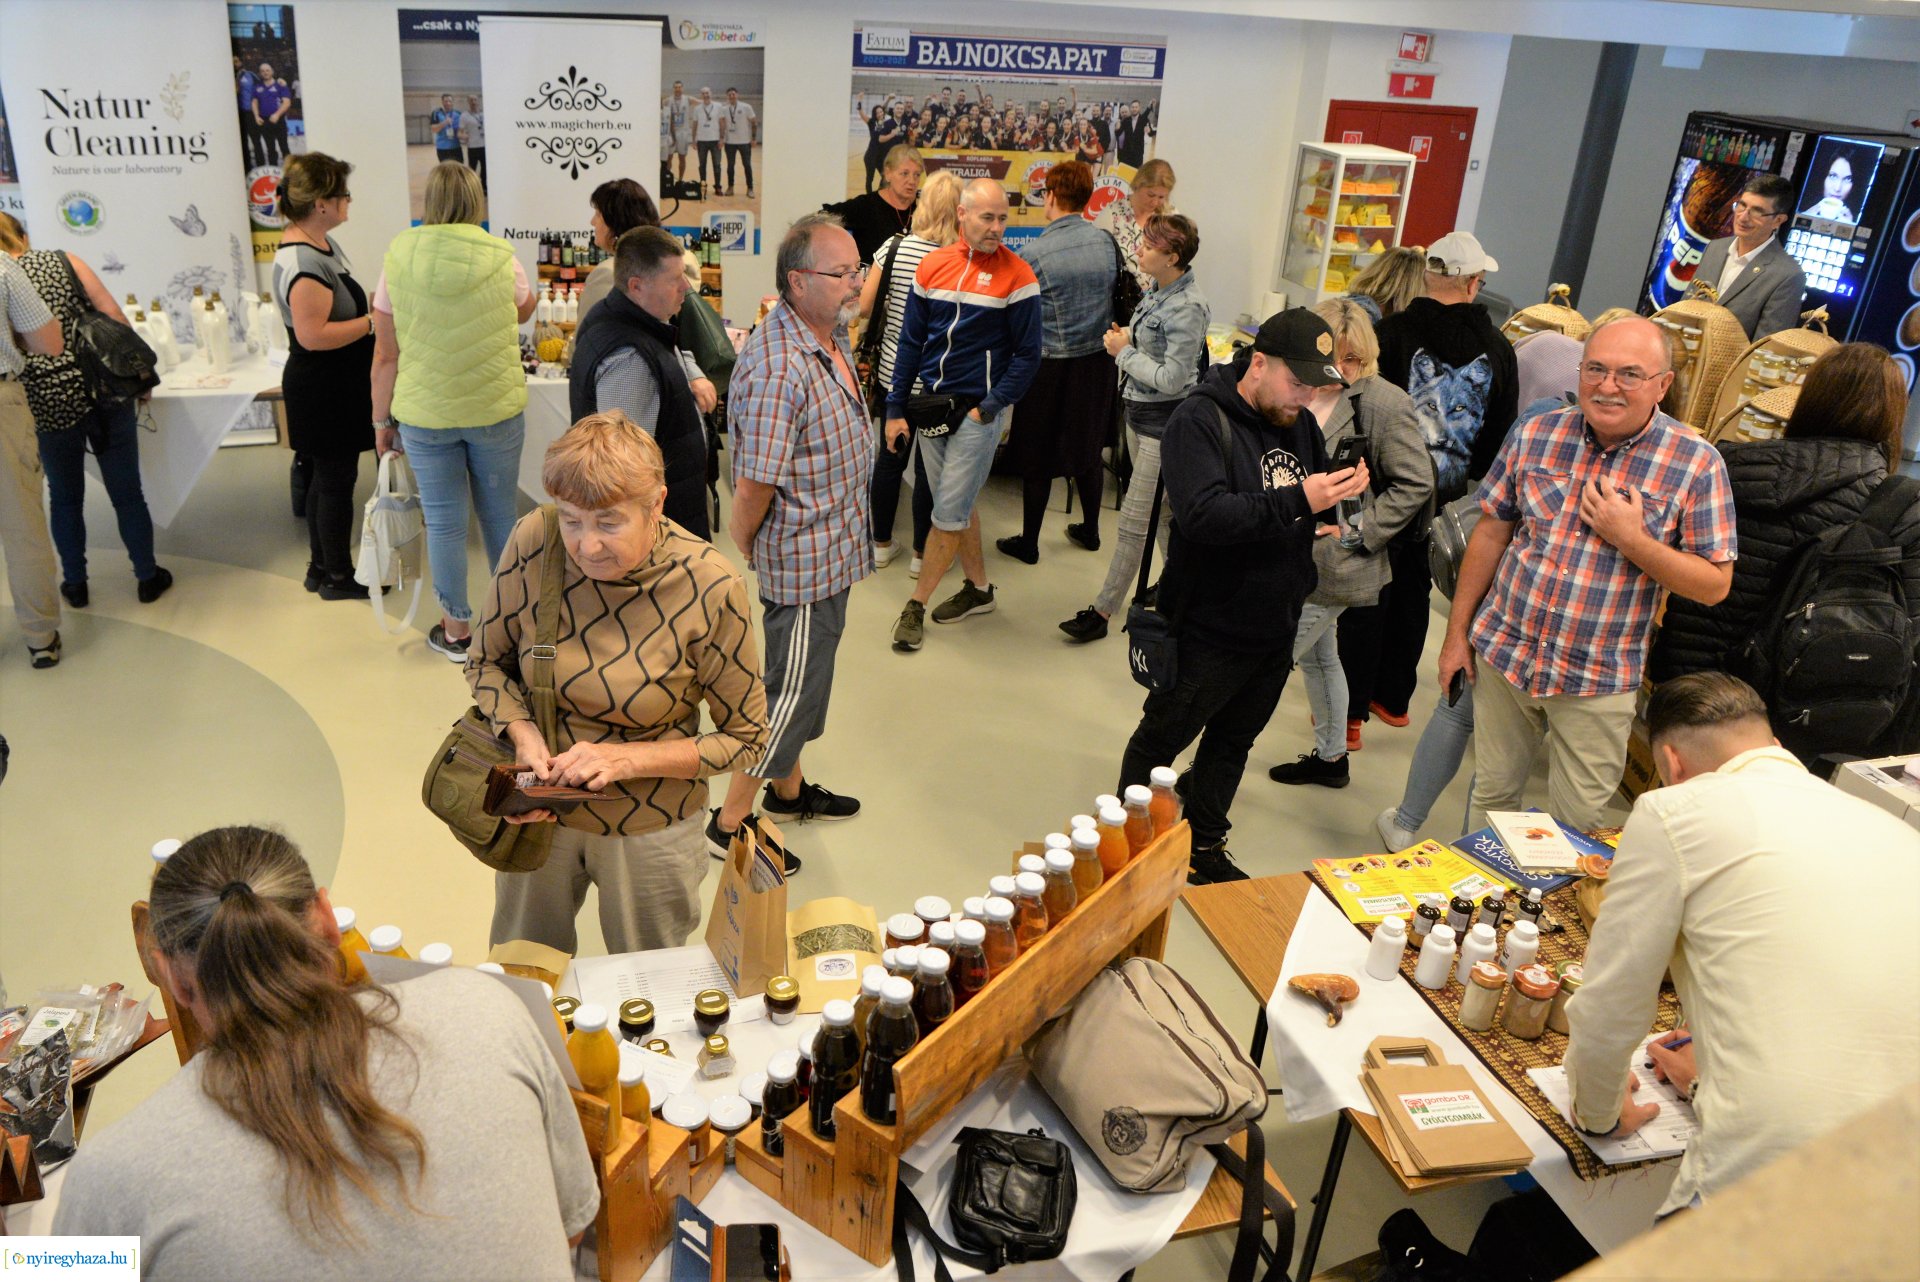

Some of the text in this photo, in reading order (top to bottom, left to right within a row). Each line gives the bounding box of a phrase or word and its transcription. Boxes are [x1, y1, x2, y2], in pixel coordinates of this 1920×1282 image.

[455, 21, 463, 31] a
[465, 20, 480, 33] Ny
[703, 31, 737, 41] Többet
[867, 33, 905, 46] FATUM
[917, 41, 1107, 72] BAJNOKCSAPAT
[40, 88, 151, 120] Natur
[516, 119, 631, 131] www.magicherb.eu
[45, 126, 209, 164] Cleaning
[52, 165, 182, 176] Nature is our laboratory
[723, 222, 743, 234] HEPP
[253, 241, 277, 255] pat
[1002, 235, 1036, 249] sapat
[1424, 1095, 1457, 1105] gomba
